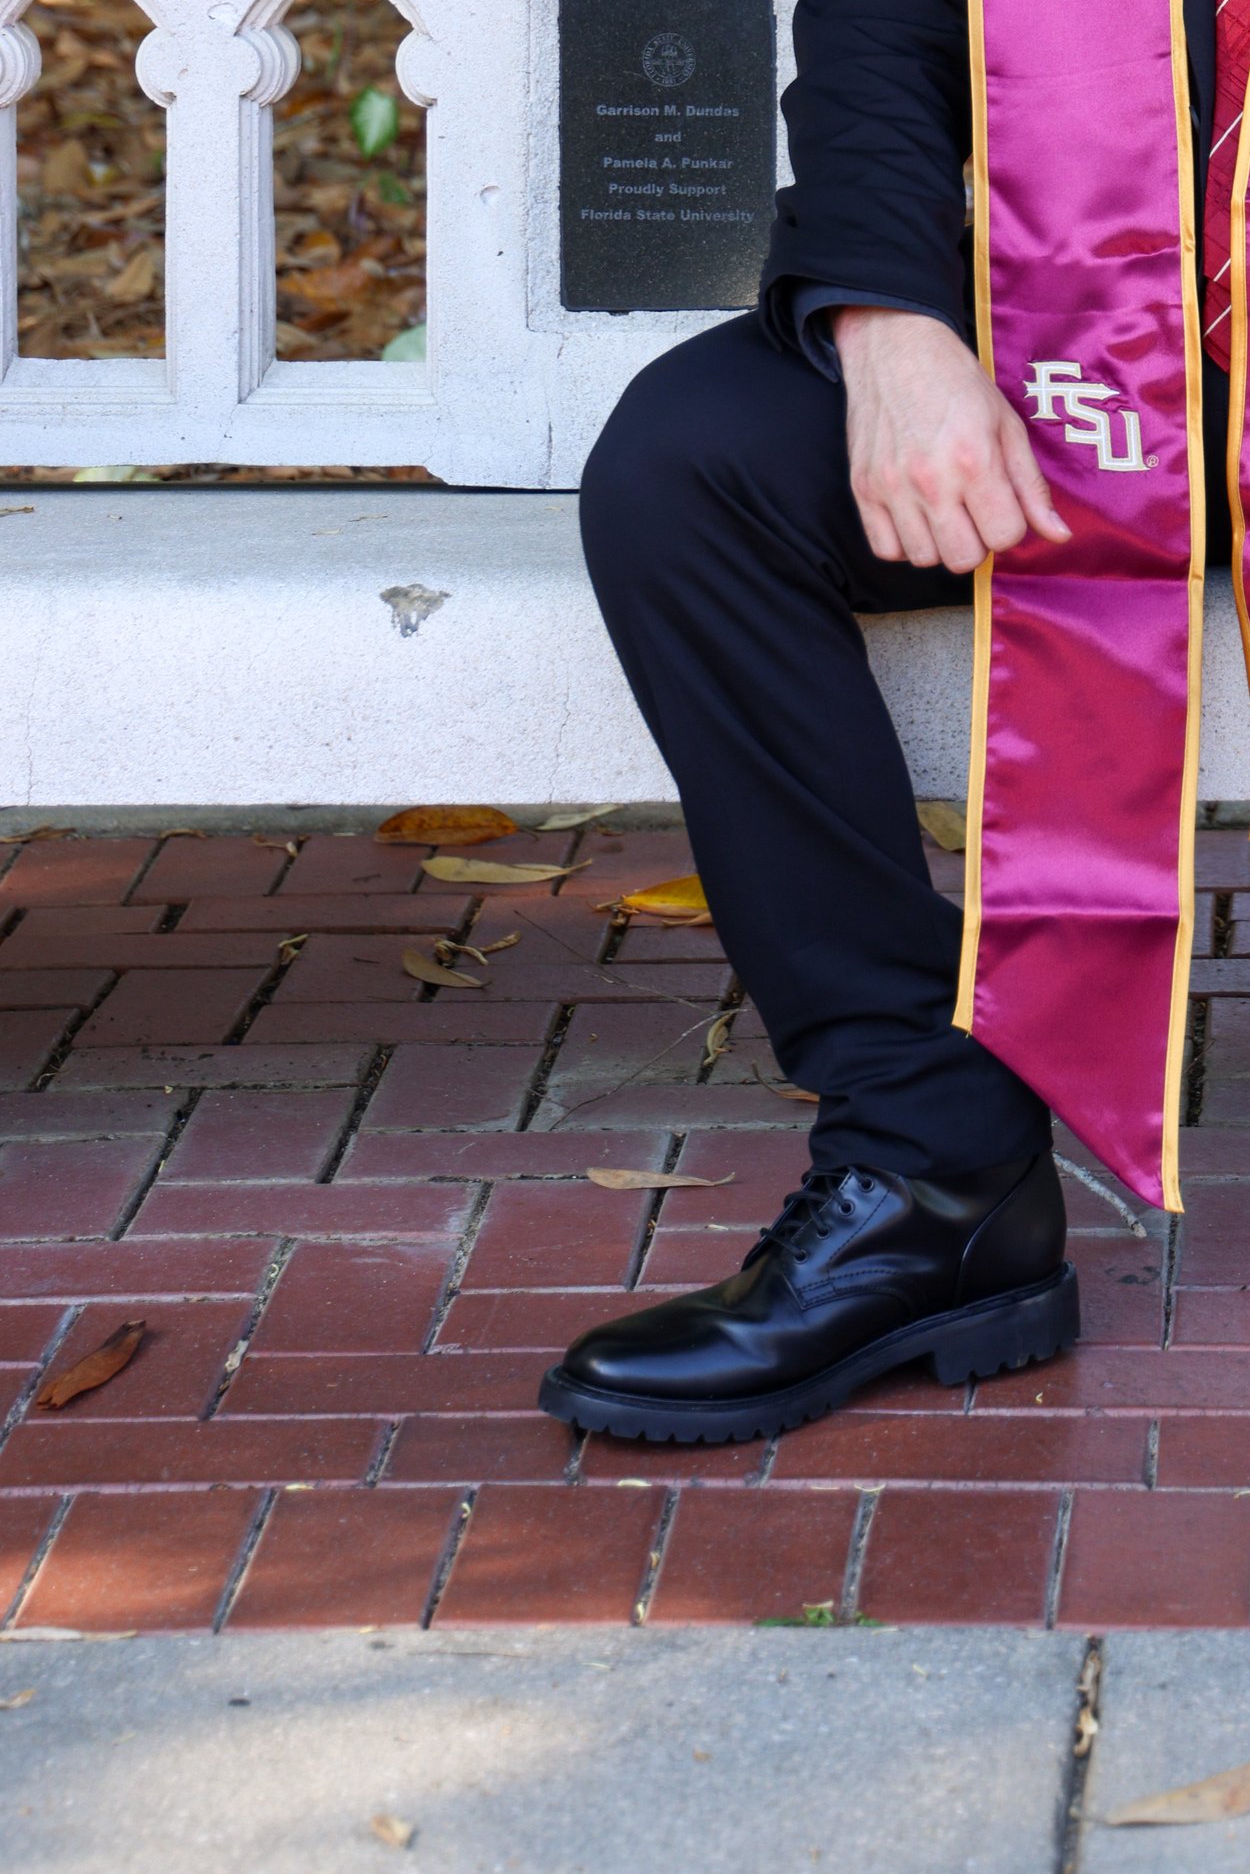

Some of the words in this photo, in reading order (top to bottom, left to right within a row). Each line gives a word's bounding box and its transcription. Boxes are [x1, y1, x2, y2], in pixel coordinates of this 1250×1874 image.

[596, 104, 659, 117] Garrison
[663, 105, 681, 117] M.
[685, 105, 740, 117] Dundas
[654, 131, 682, 142] and
[603, 157, 658, 168] Pamela
[661, 157, 676, 168] A.
[681, 157, 733, 169] Punkar
[608, 183, 664, 197] Proudly
[669, 183, 727, 197] Support
[580, 209, 632, 220] Florida
[636, 209, 675, 221] State
[680, 209, 755, 224] University
[1022, 360, 1151, 472] FSU
